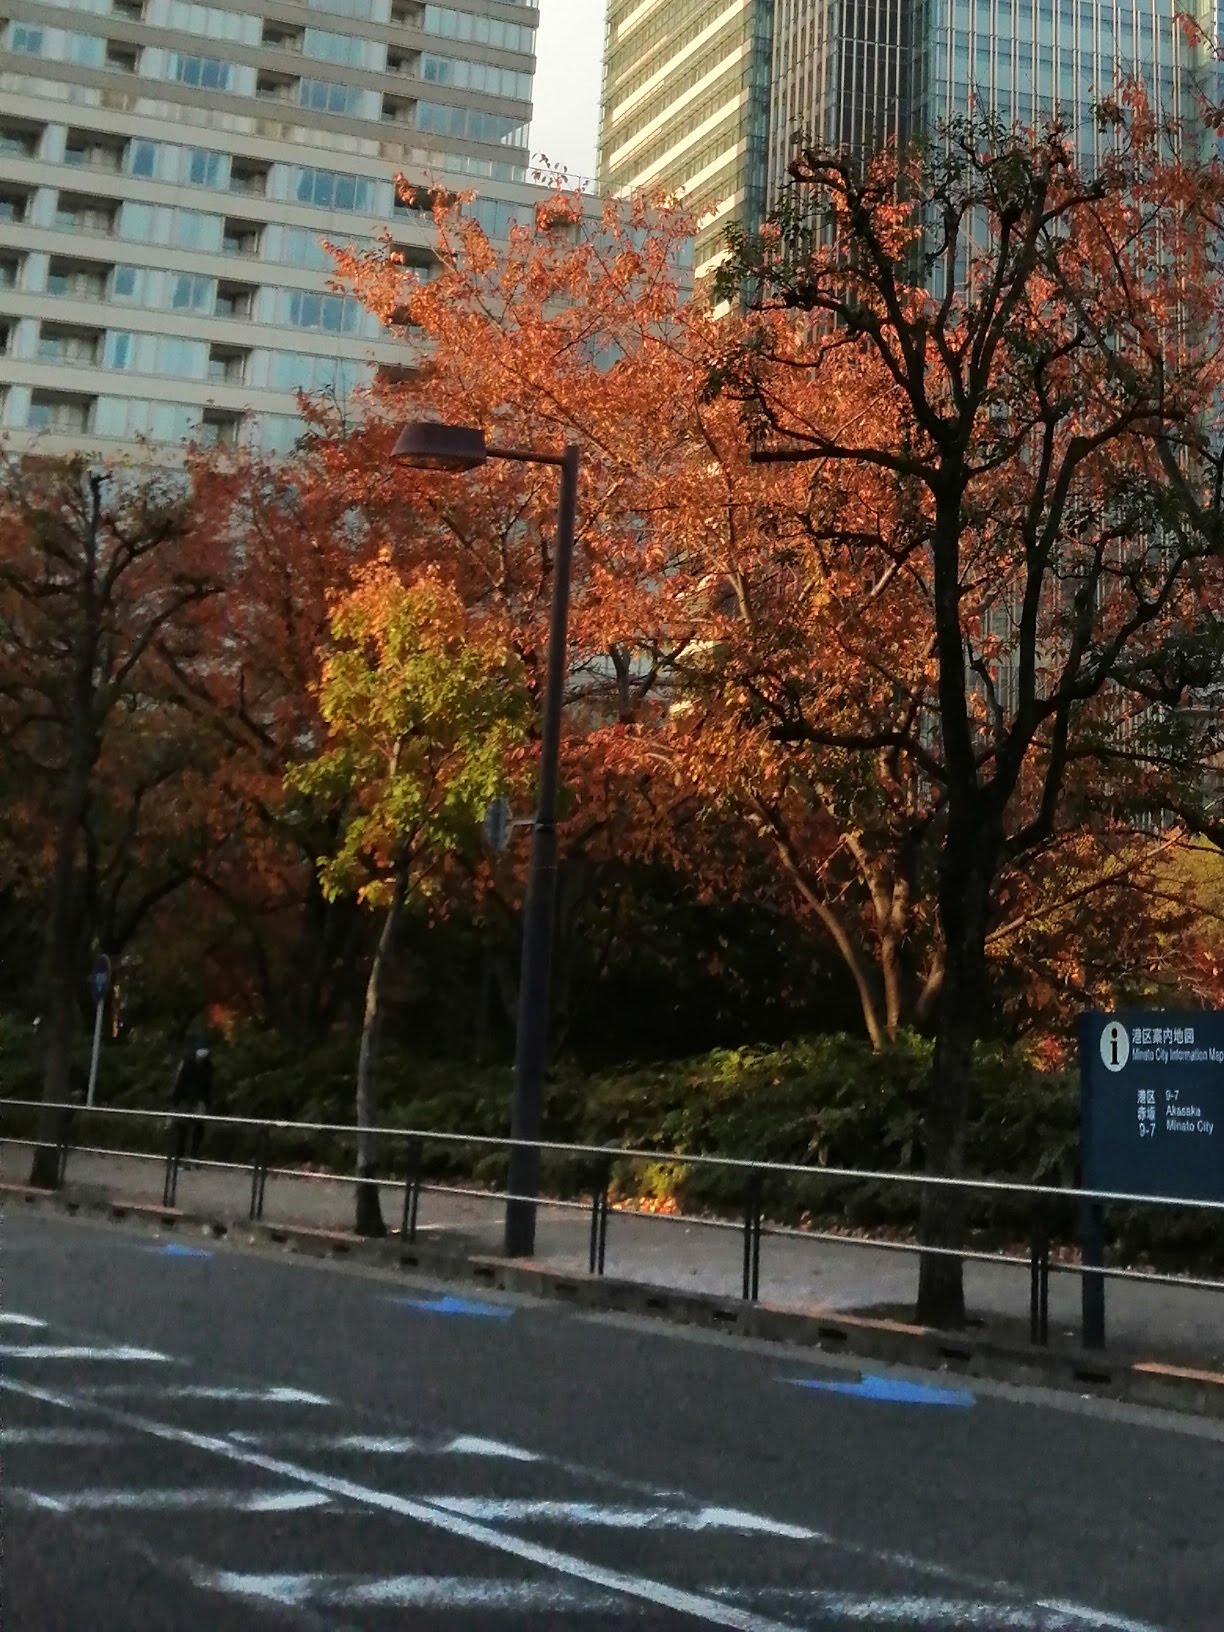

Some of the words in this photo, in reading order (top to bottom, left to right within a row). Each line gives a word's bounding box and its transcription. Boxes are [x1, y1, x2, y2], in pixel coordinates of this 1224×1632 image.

[1131, 1027, 1195, 1045] 港区案内地図
[1132, 1047, 1154, 1062] Minato
[1155, 1047, 1169, 1065] City
[1169, 1047, 1208, 1062] Information
[1208, 1047, 1224, 1064] Map
[1136, 1088, 1156, 1105] 港区
[1165, 1089, 1180, 1102] 9-7
[1137, 1106, 1156, 1122] 赤坂
[1165, 1104, 1201, 1117] Akasaka
[1138, 1122, 1156, 1138] 9-7
[1165, 1118, 1195, 1133] Minato
[1196, 1119, 1214, 1136] City
